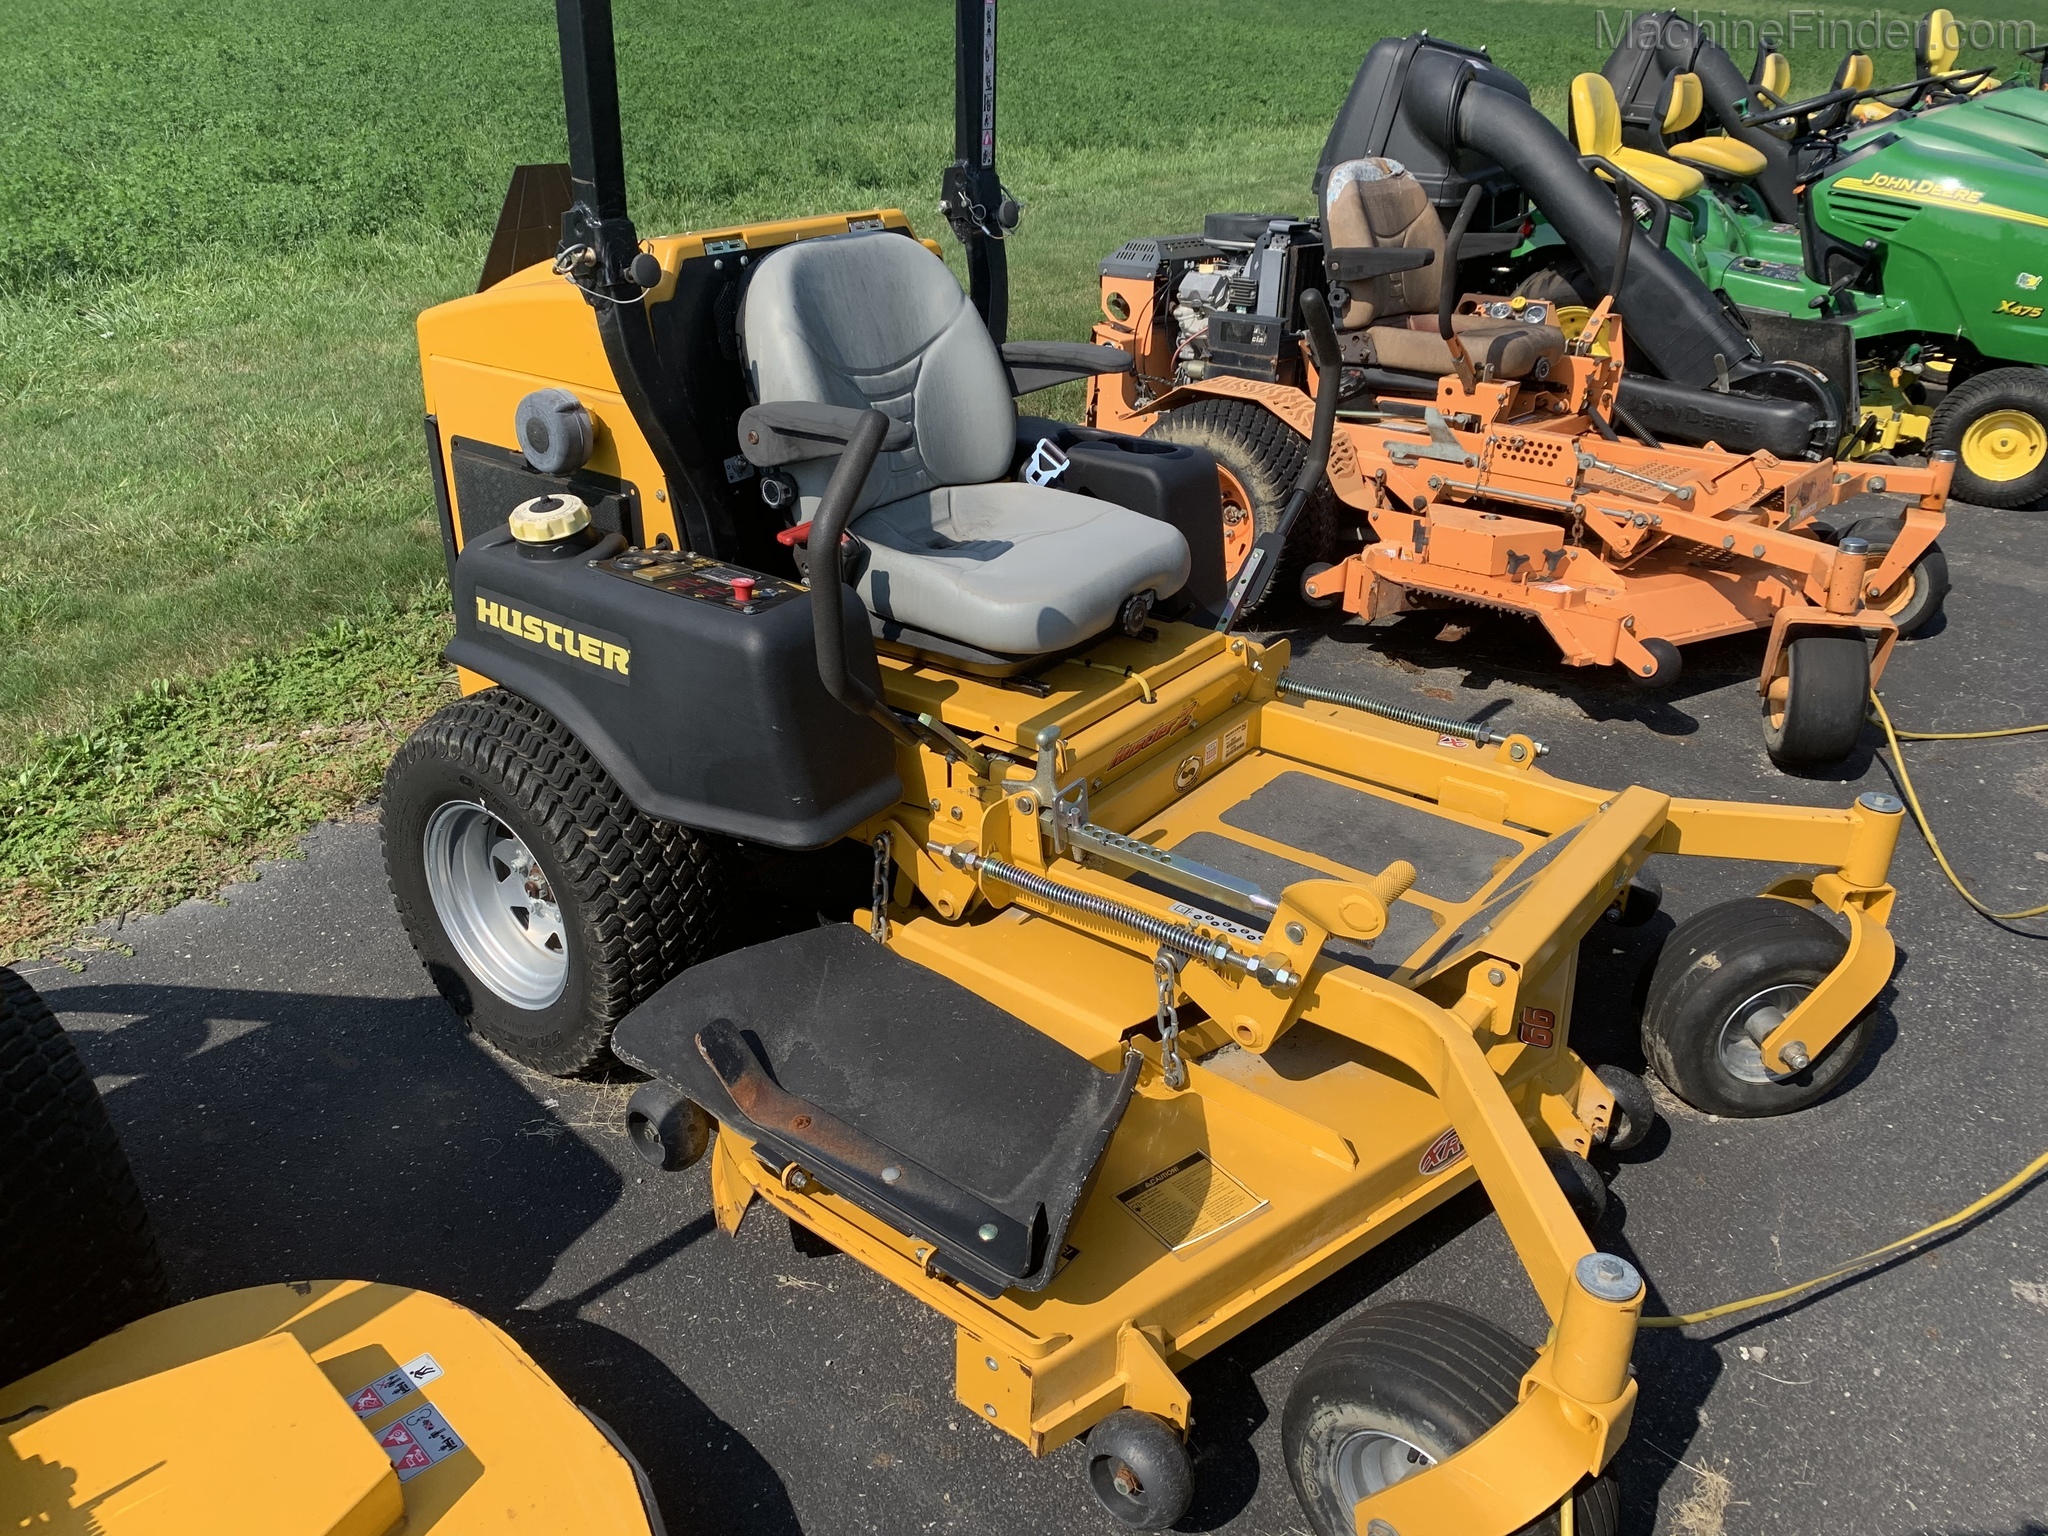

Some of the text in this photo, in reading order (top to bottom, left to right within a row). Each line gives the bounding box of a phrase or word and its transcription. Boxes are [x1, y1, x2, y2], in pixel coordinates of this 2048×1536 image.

[1863, 172, 1985, 203] JOHN DEERE
[1996, 300, 2044, 318] X475
[1624, 395, 1757, 436] JOHN DEERE
[476, 596, 630, 676] HUSTLER
